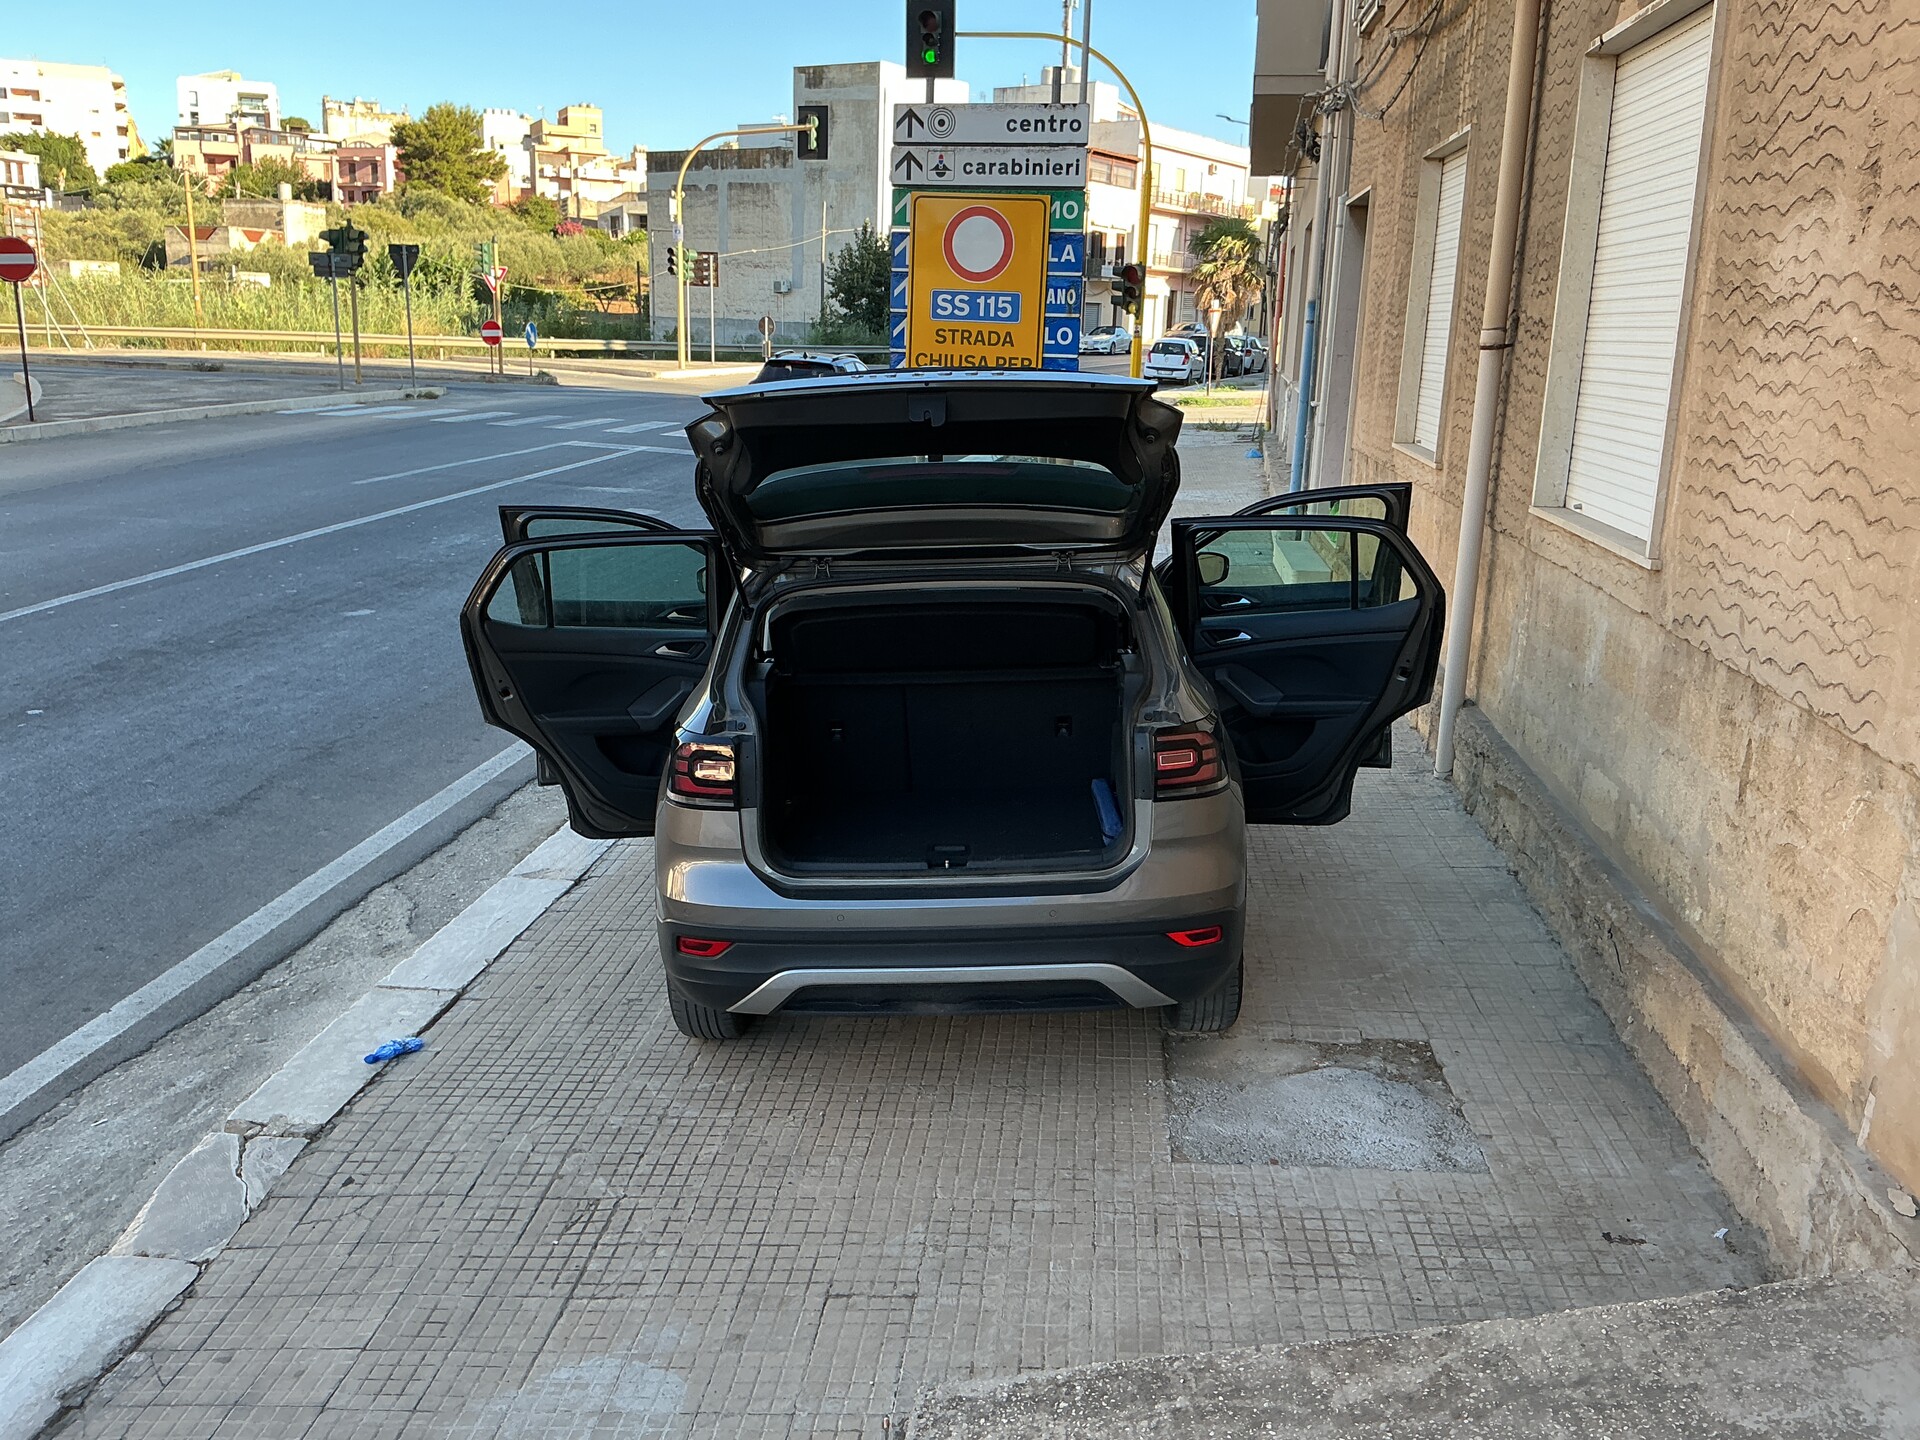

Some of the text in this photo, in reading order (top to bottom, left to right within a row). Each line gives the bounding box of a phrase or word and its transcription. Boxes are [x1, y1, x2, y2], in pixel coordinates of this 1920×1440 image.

[1006, 114, 1082, 132] centro
[963, 158, 1080, 175] carabinieri
[936, 294, 1012, 318] SS 115
[935, 328, 1015, 348] STRADA
[915, 352, 988, 368] CHIUSA
